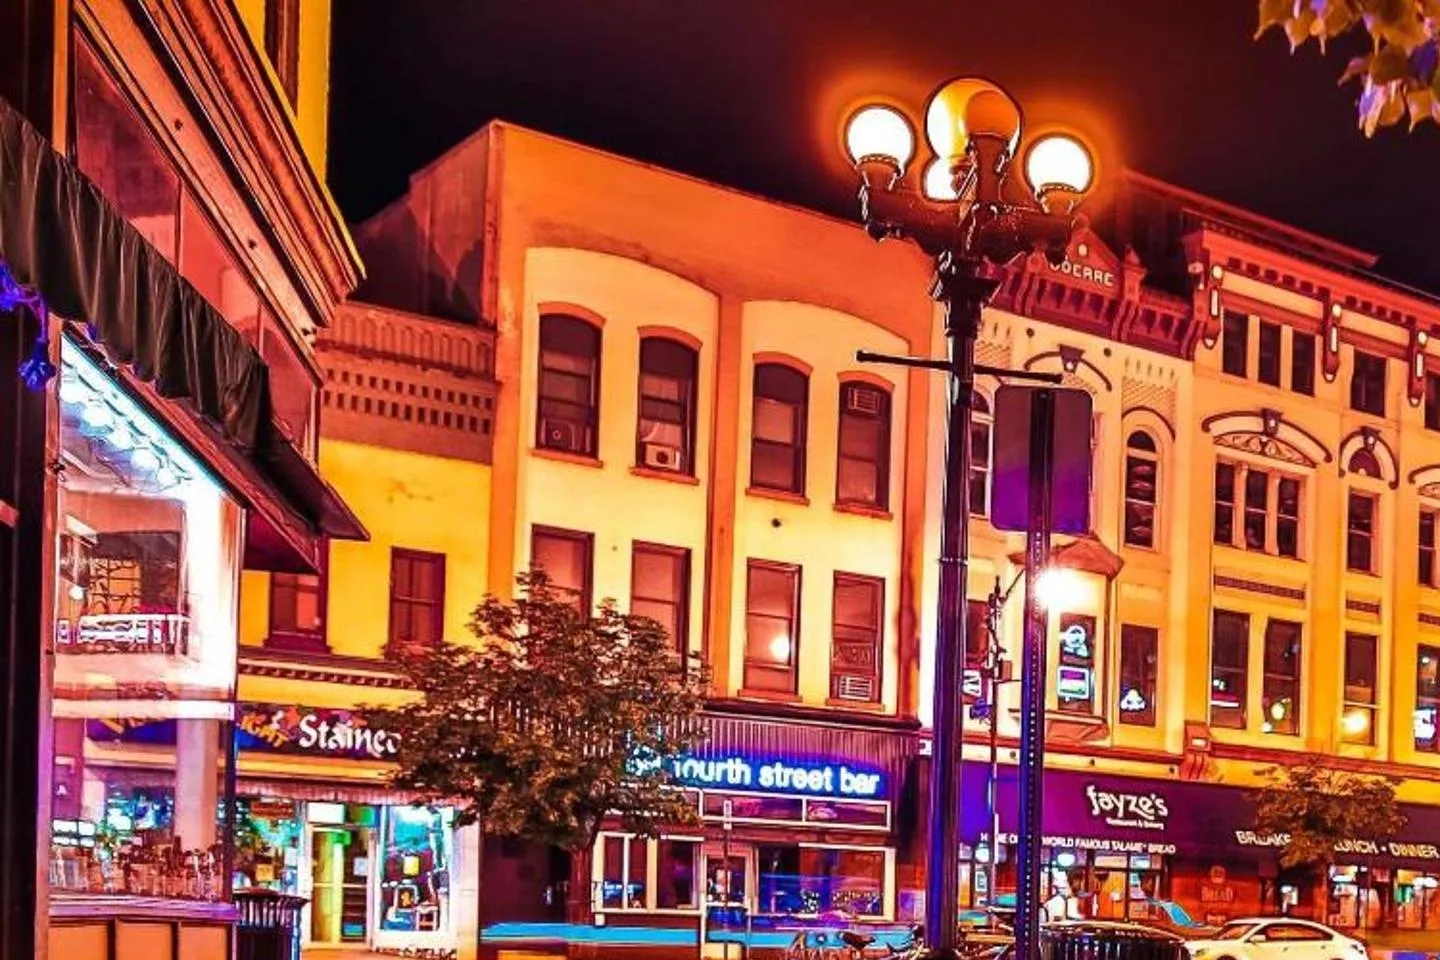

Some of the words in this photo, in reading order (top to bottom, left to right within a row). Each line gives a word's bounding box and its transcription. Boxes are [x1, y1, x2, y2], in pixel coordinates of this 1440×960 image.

[759, 762, 833, 792] street
[840, 767, 880, 795] bar
[1086, 785, 1169, 821] fayze's
[1041, 836, 1074, 849] WORLD
[1074, 838, 1110, 851] FAMOUS
[1147, 843, 1176, 855] BREAD
[1388, 842, 1440, 859] DINNER
